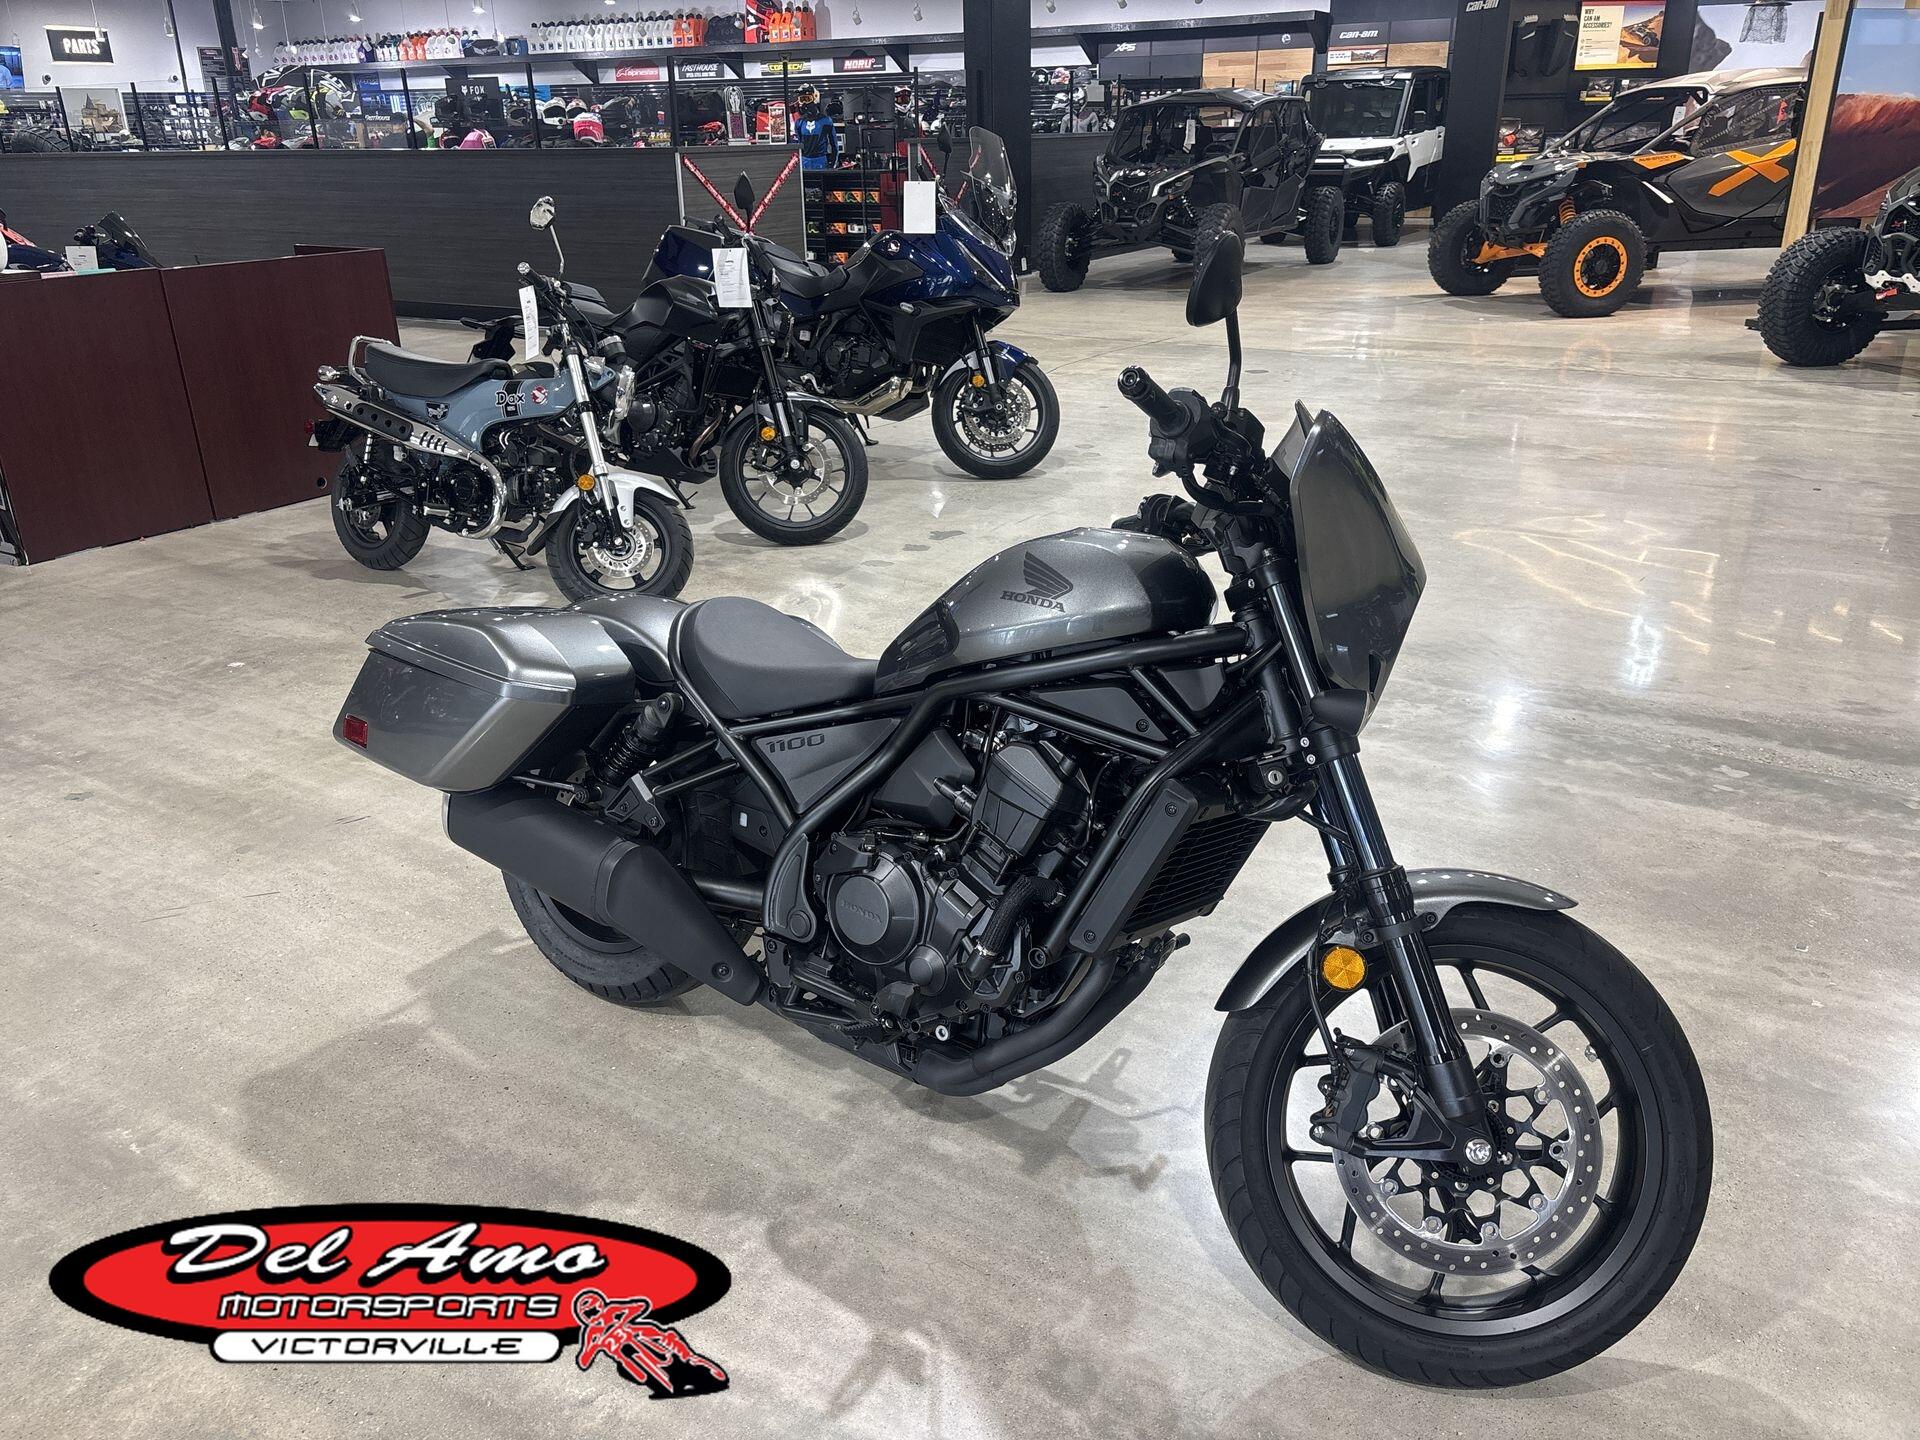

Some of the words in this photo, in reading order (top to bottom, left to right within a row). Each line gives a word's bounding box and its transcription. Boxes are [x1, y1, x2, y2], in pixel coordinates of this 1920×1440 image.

[1339, 29, 1379, 39] can-am
[62, 37, 101, 55] PARTS
[1114, 41, 1137, 52] XPS
[469, 85, 485, 95] FOX
[495, 389, 526, 407] Dax
[999, 590, 1066, 613] HONDA
[766, 733, 825, 754] 1100
